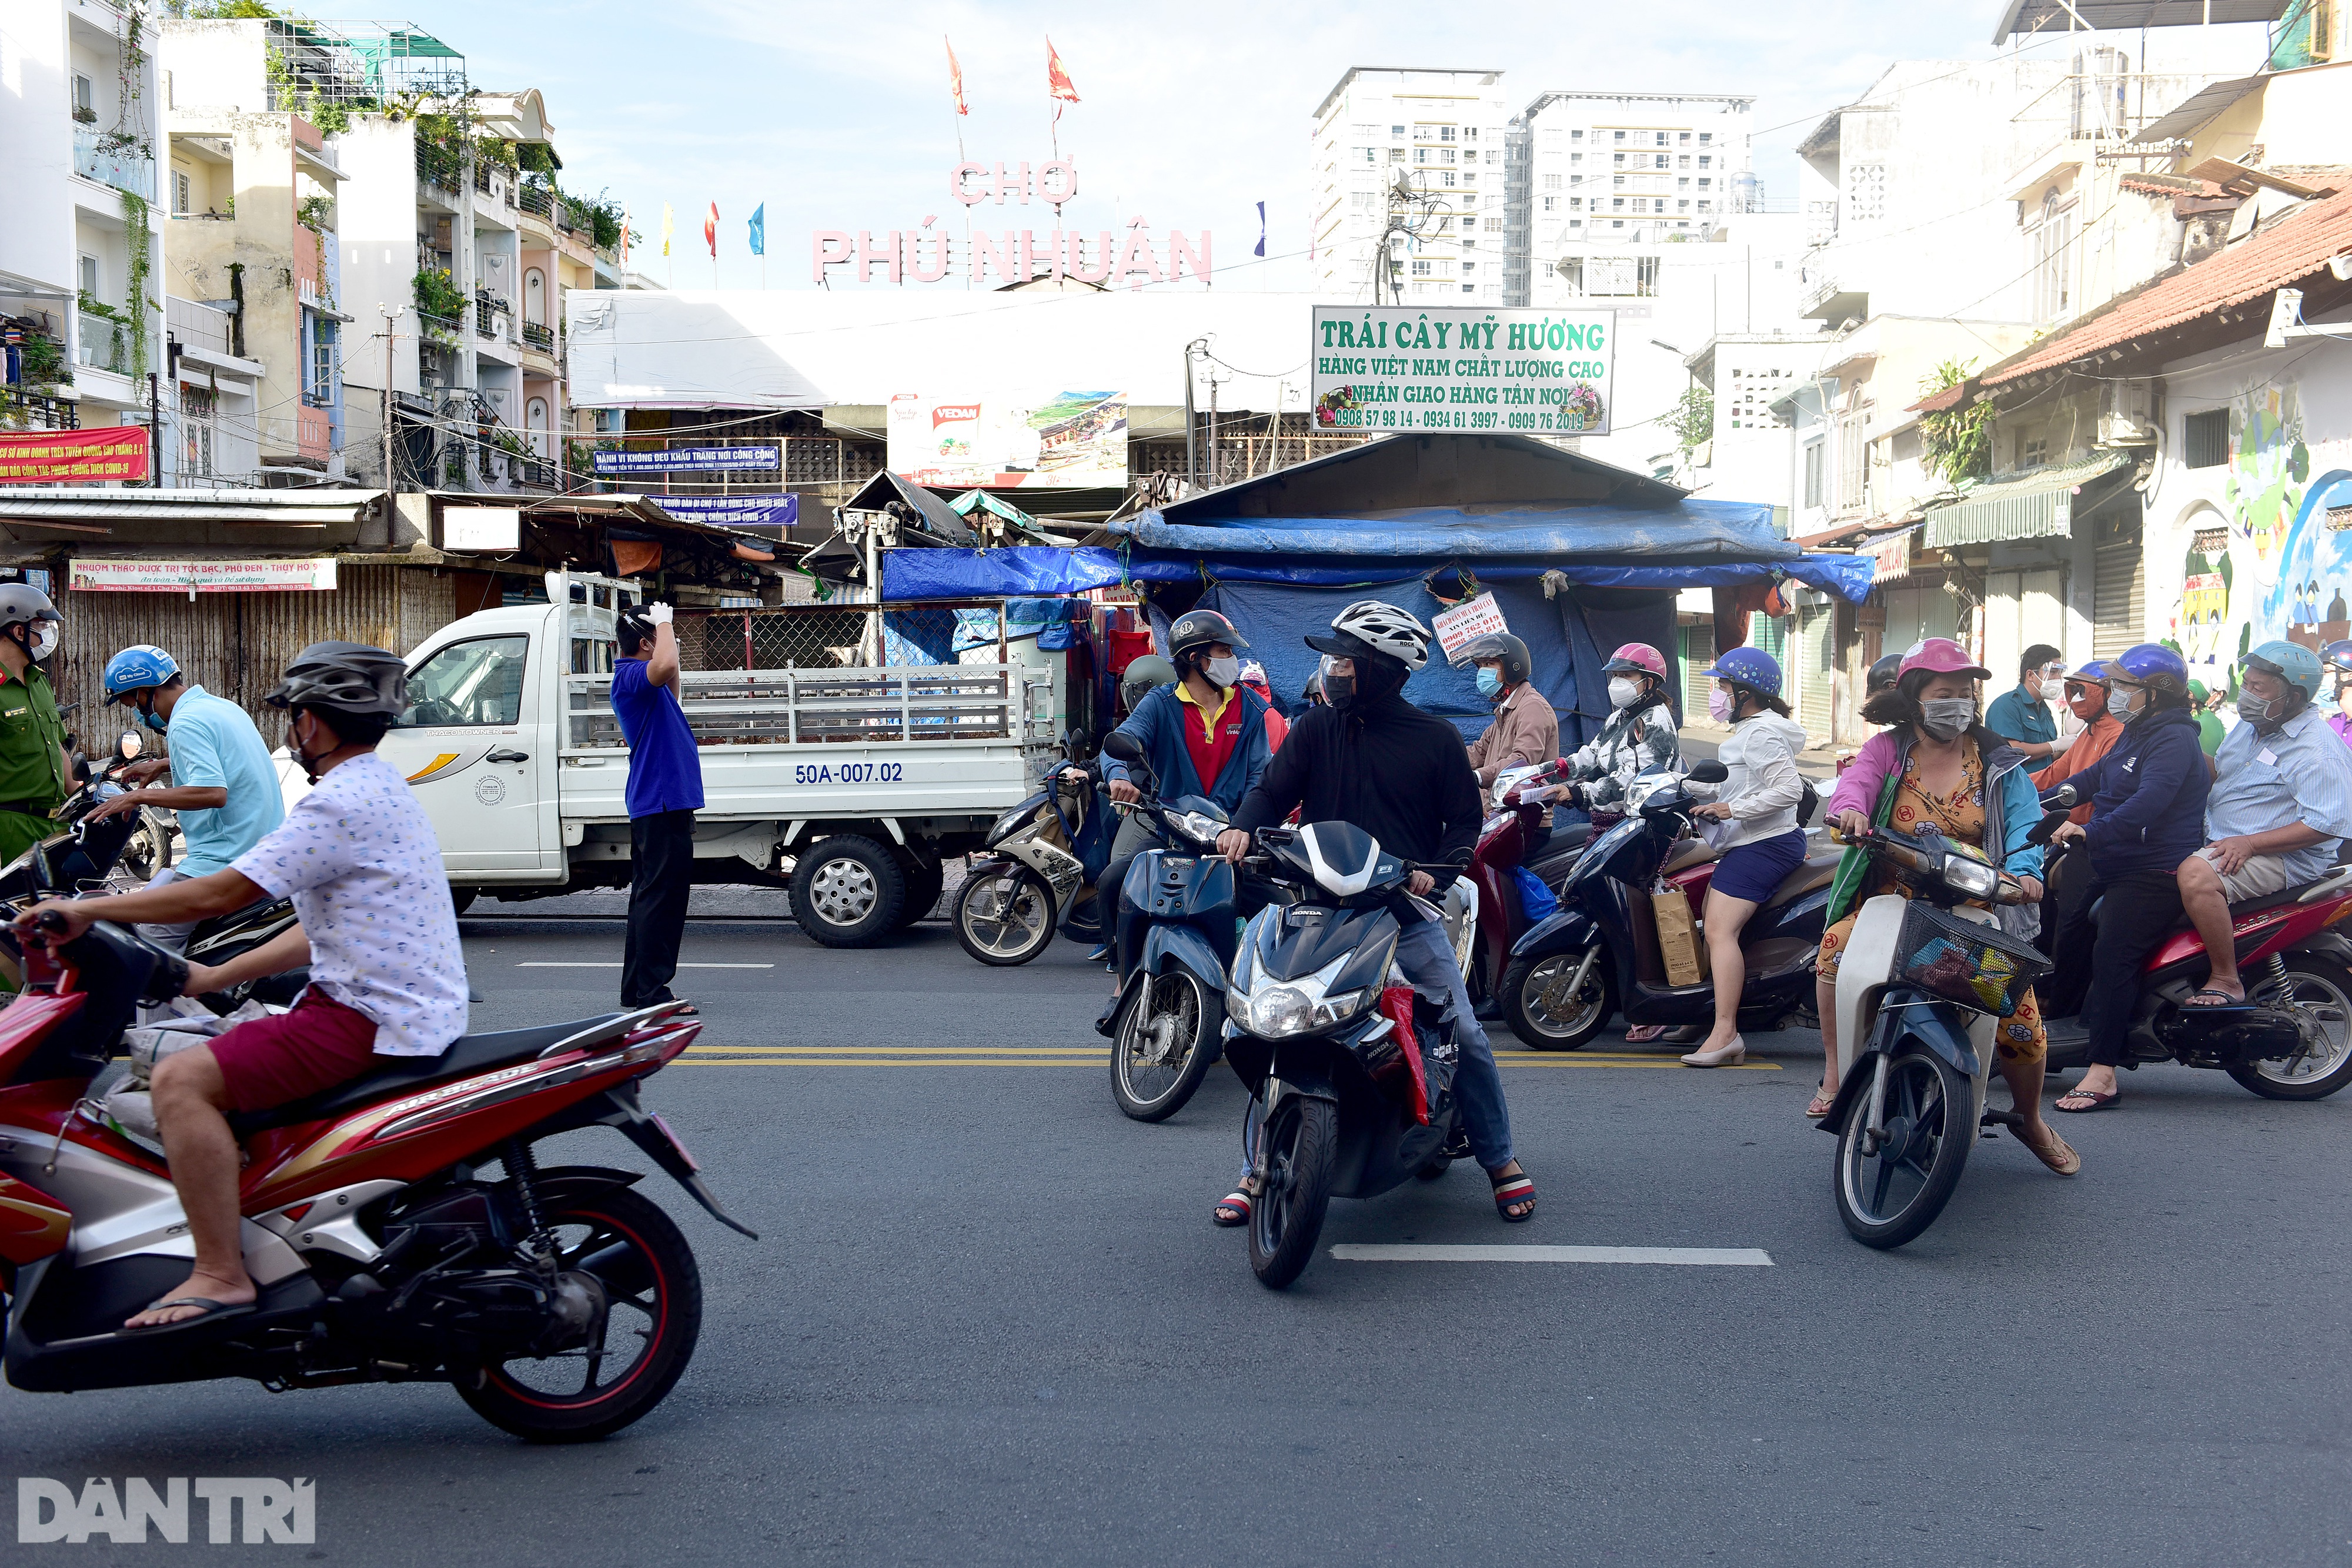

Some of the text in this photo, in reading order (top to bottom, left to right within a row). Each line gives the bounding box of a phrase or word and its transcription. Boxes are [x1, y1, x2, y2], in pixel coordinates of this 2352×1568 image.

[951, 154, 1077, 213] CHỢ
[813, 215, 1211, 291] PHÚ NHUẬN
[1321, 313, 1604, 352] TRÁI CÂY MỸ HƯƠNG
[1318, 353, 1604, 382] HÀNG VIỆT NAM CHẤT LƯỢNG CAO
[1352, 381, 1569, 409] NHẬN GIAO HÀNG TẬN NƠI
[936, 407, 977, 419] VEDAN
[1334, 409, 1584, 430] 0908 57 98 14 0934 61 3997 0909 76 2019
[16, 447, 30, 458] KINH
[31, 447, 49, 457] DOANH
[51, 445, 64, 457] TRÊN
[65, 443, 82, 457] TUYẾN
[103, 446, 114, 456] CAO
[115, 441, 133, 456] THÁNG
[139, 444, 143, 455] B
[597, 453, 616, 463] HÀNH
[618, 454, 625, 463] VI
[627, 453, 653, 463] KHÔNG
[654, 453, 669, 462] ĐEO
[693, 452, 716, 460] TRANG
[718, 450, 731, 460] NƠI
[733, 449, 753, 459] CÔNG
[755, 449, 775, 460] CỘNG
[9, 463, 21, 477] BẢO
[38, 464, 49, 476] TÁC
[71, 461, 89, 474] CHỐNG
[91, 463, 103, 476] DỊCH
[105, 462, 129, 474] COVID-19
[700, 499, 712, 509] CHỢ
[744, 499, 755, 507] CHO
[708, 510, 727, 521] CHỐNG
[728, 513, 740, 522] DỊCH
[742, 513, 758, 521] COVID
[763, 513, 769, 521] 19
[1892, 544, 1902, 570] LAN
[76, 563, 108, 573] NHUỘM
[112, 563, 135, 572] THẢO
[138, 564, 162, 574] DƯỢC
[165, 565, 179, 574] TRỊ
[202, 565, 222, 574] BẠC,
[245, 564, 262, 573] ĐEN
[271, 564, 294, 574] THỤY
[1436, 617, 1453, 630] KHÁCH
[1461, 607, 1472, 618] MUA
[1485, 621, 1502, 633] 814
[1442, 614, 1499, 644] 0909 762 019
[1448, 624, 1460, 632] XIN
[796, 763, 903, 784] 50A-007.02
[1979, 969, 2002, 980] HONDA
[1367, 1042, 1389, 1060] HONDA
